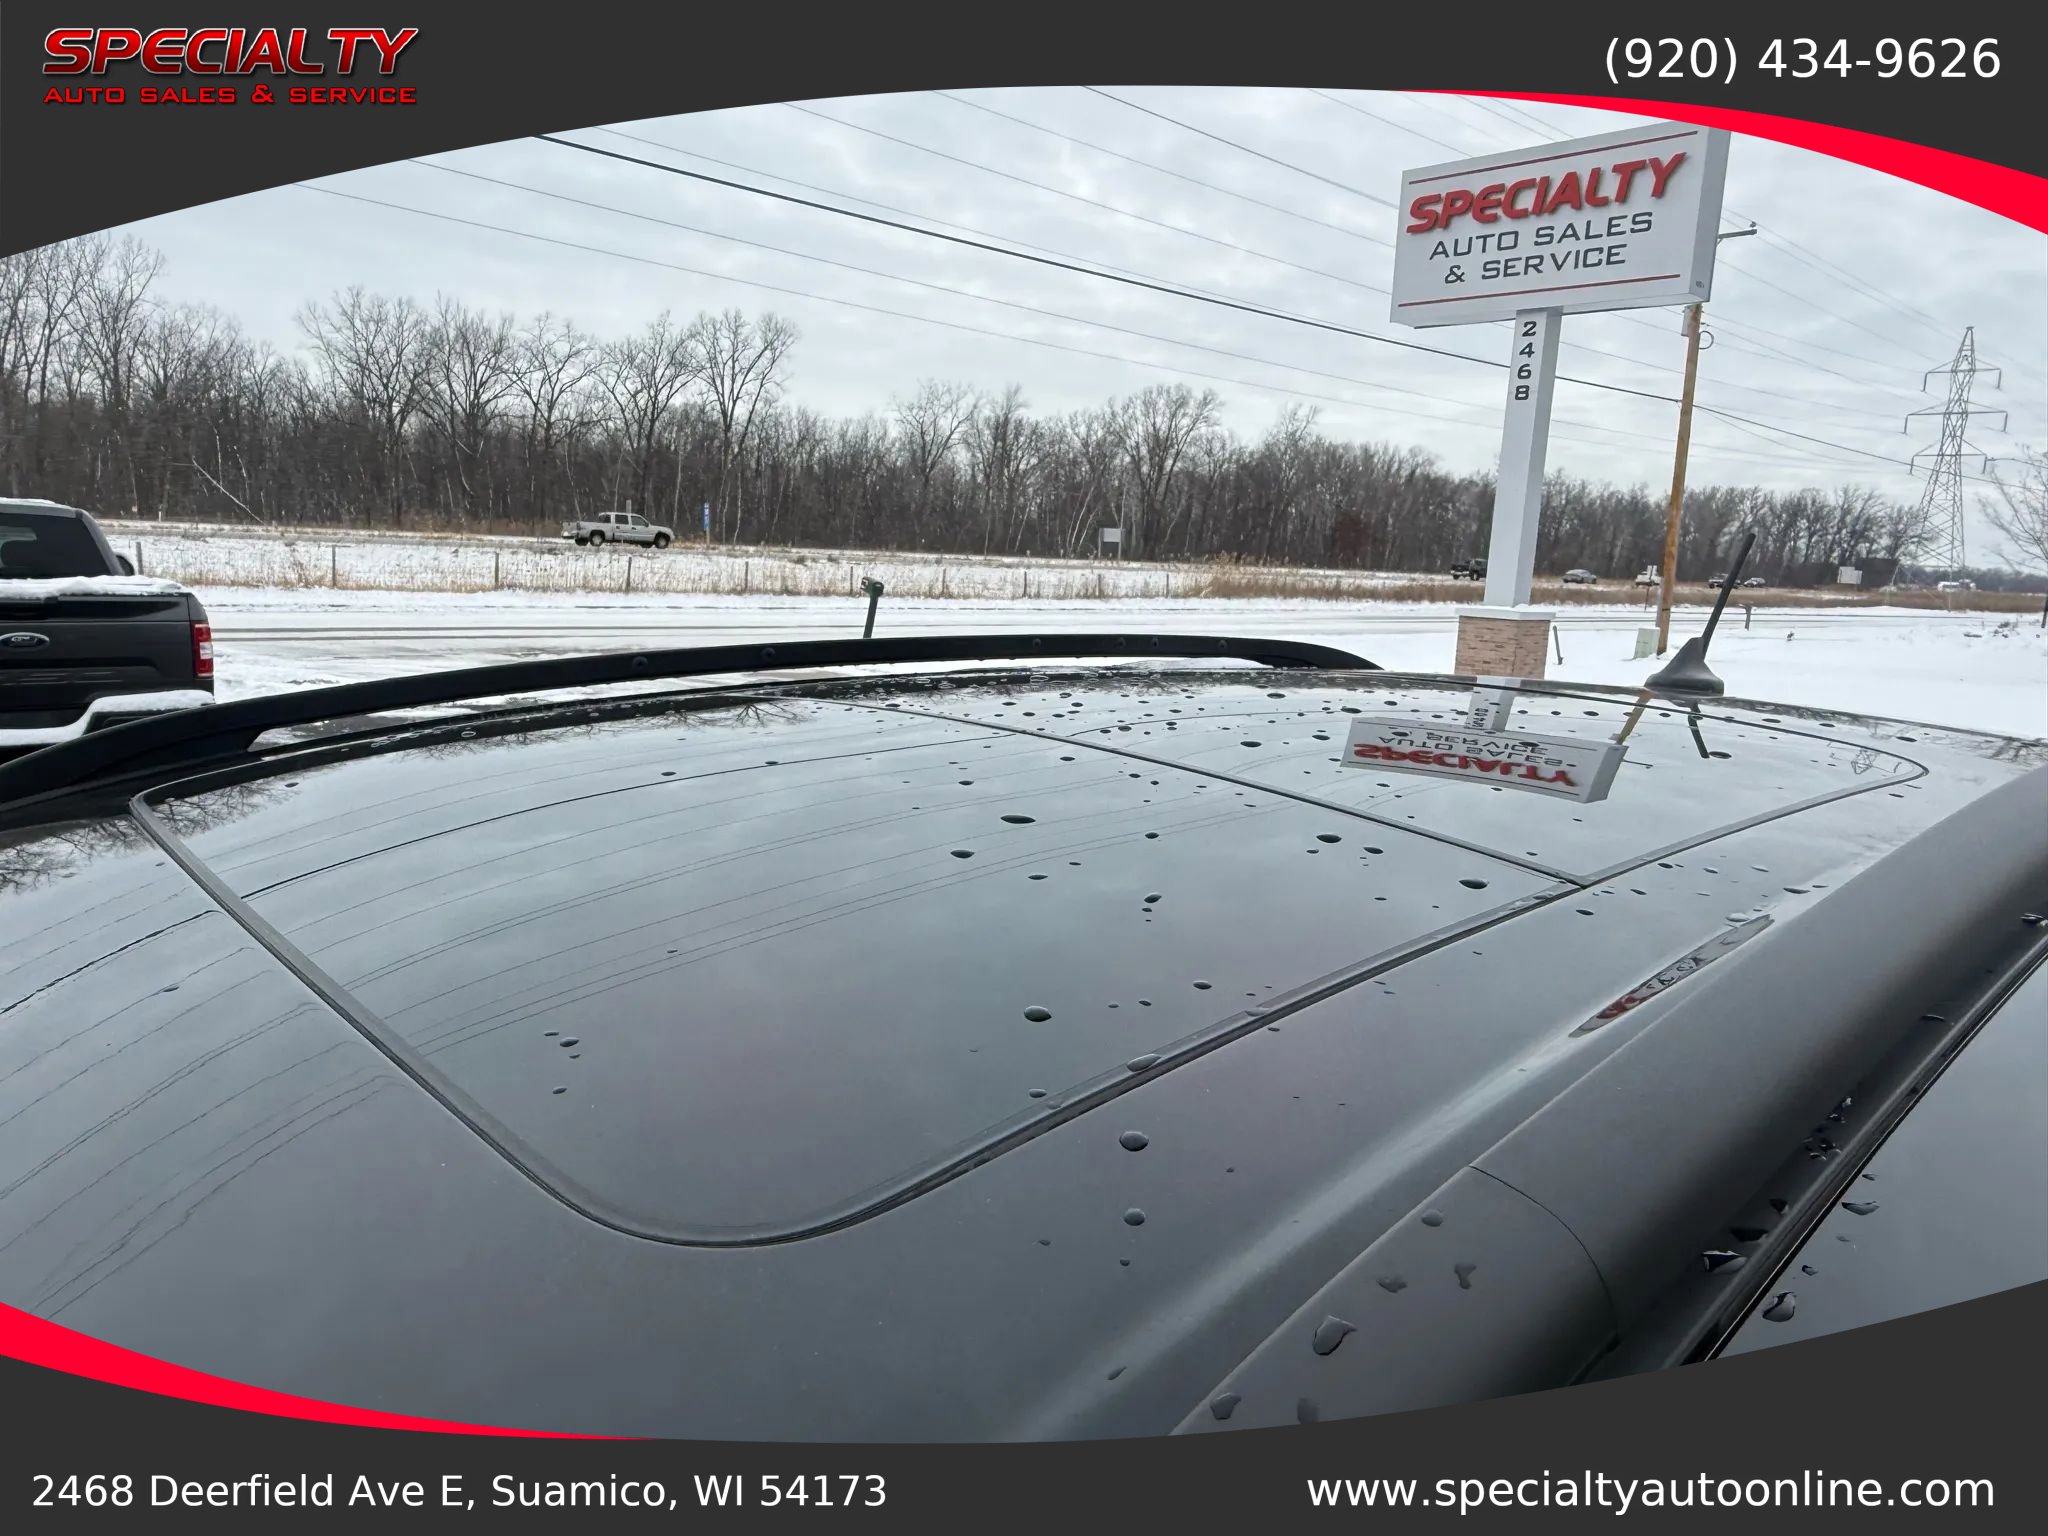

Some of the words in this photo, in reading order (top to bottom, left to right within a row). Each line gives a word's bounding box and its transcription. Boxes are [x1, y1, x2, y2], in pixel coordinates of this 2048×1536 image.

[1406, 151, 1688, 234] SPECIALTY
[1429, 230, 1520, 261] AUTO
[1533, 211, 1654, 247] SALES
[1444, 264, 1466, 285] &
[1481, 243, 1628, 281] SERVICE
[1514, 321, 1538, 402] 2468
